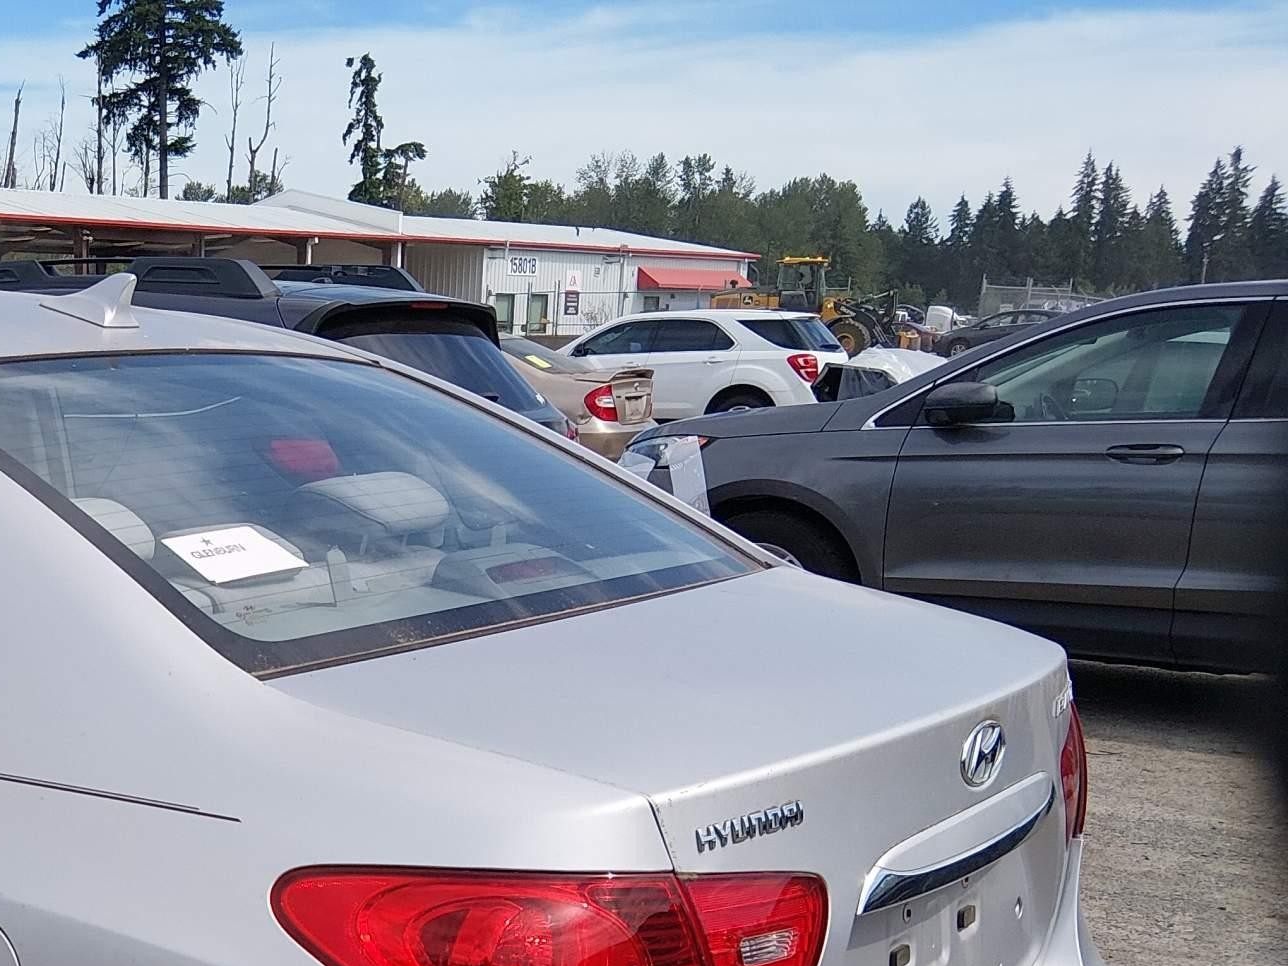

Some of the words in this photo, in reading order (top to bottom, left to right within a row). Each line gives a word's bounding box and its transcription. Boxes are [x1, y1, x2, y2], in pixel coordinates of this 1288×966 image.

[509, 256, 537, 275] 15801B
[190, 543, 247, 560] GLENBURN
[695, 800, 804, 854] HYUNDAI
